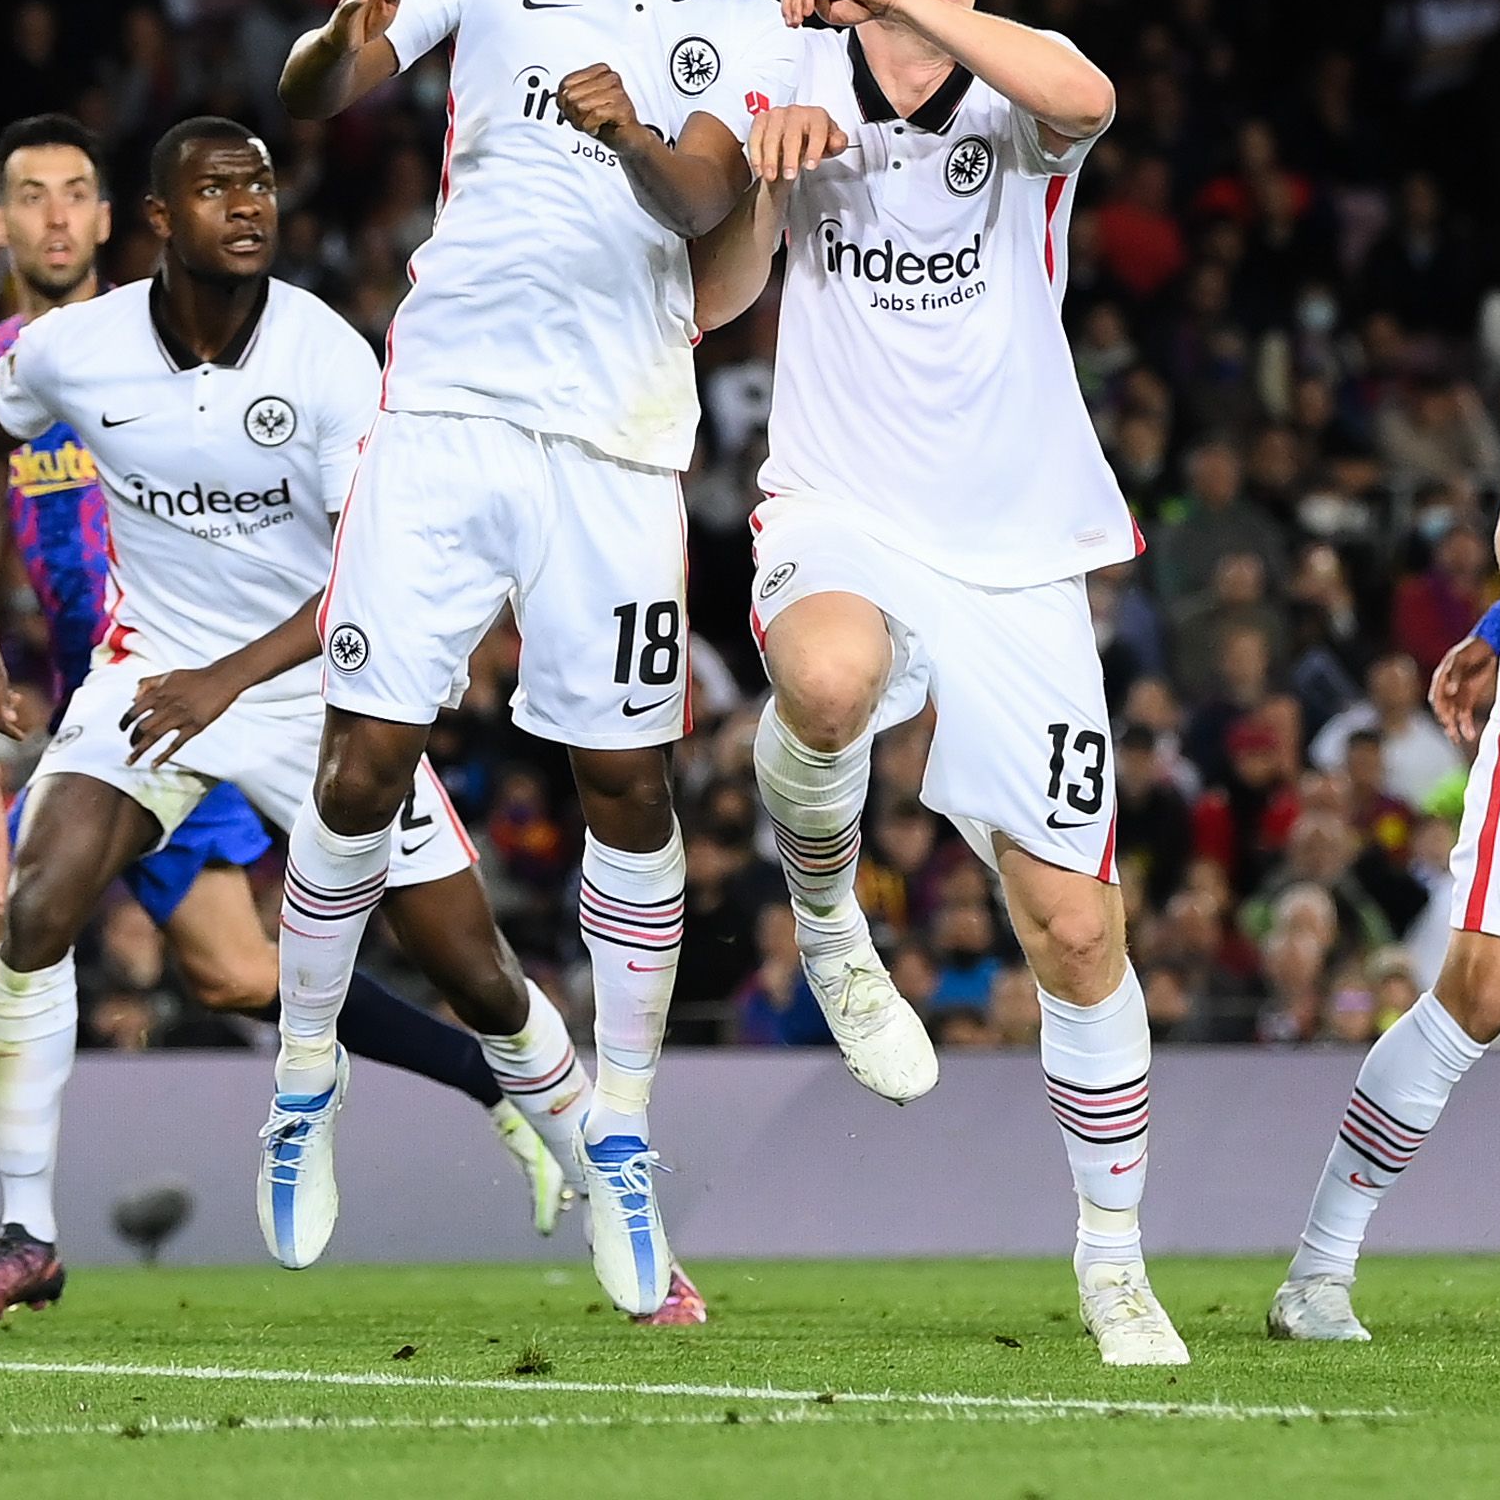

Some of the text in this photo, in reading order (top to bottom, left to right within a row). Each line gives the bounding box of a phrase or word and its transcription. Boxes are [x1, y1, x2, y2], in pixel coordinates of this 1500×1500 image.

[571, 140, 618, 167] Jobs
[825, 228, 981, 286] indeed
[870, 280, 987, 311] Jobs finden
[130, 477, 291, 517] indeed
[236, 510, 295, 536] finden
[613, 600, 679, 685] 18
[1047, 723, 1106, 816] 13
